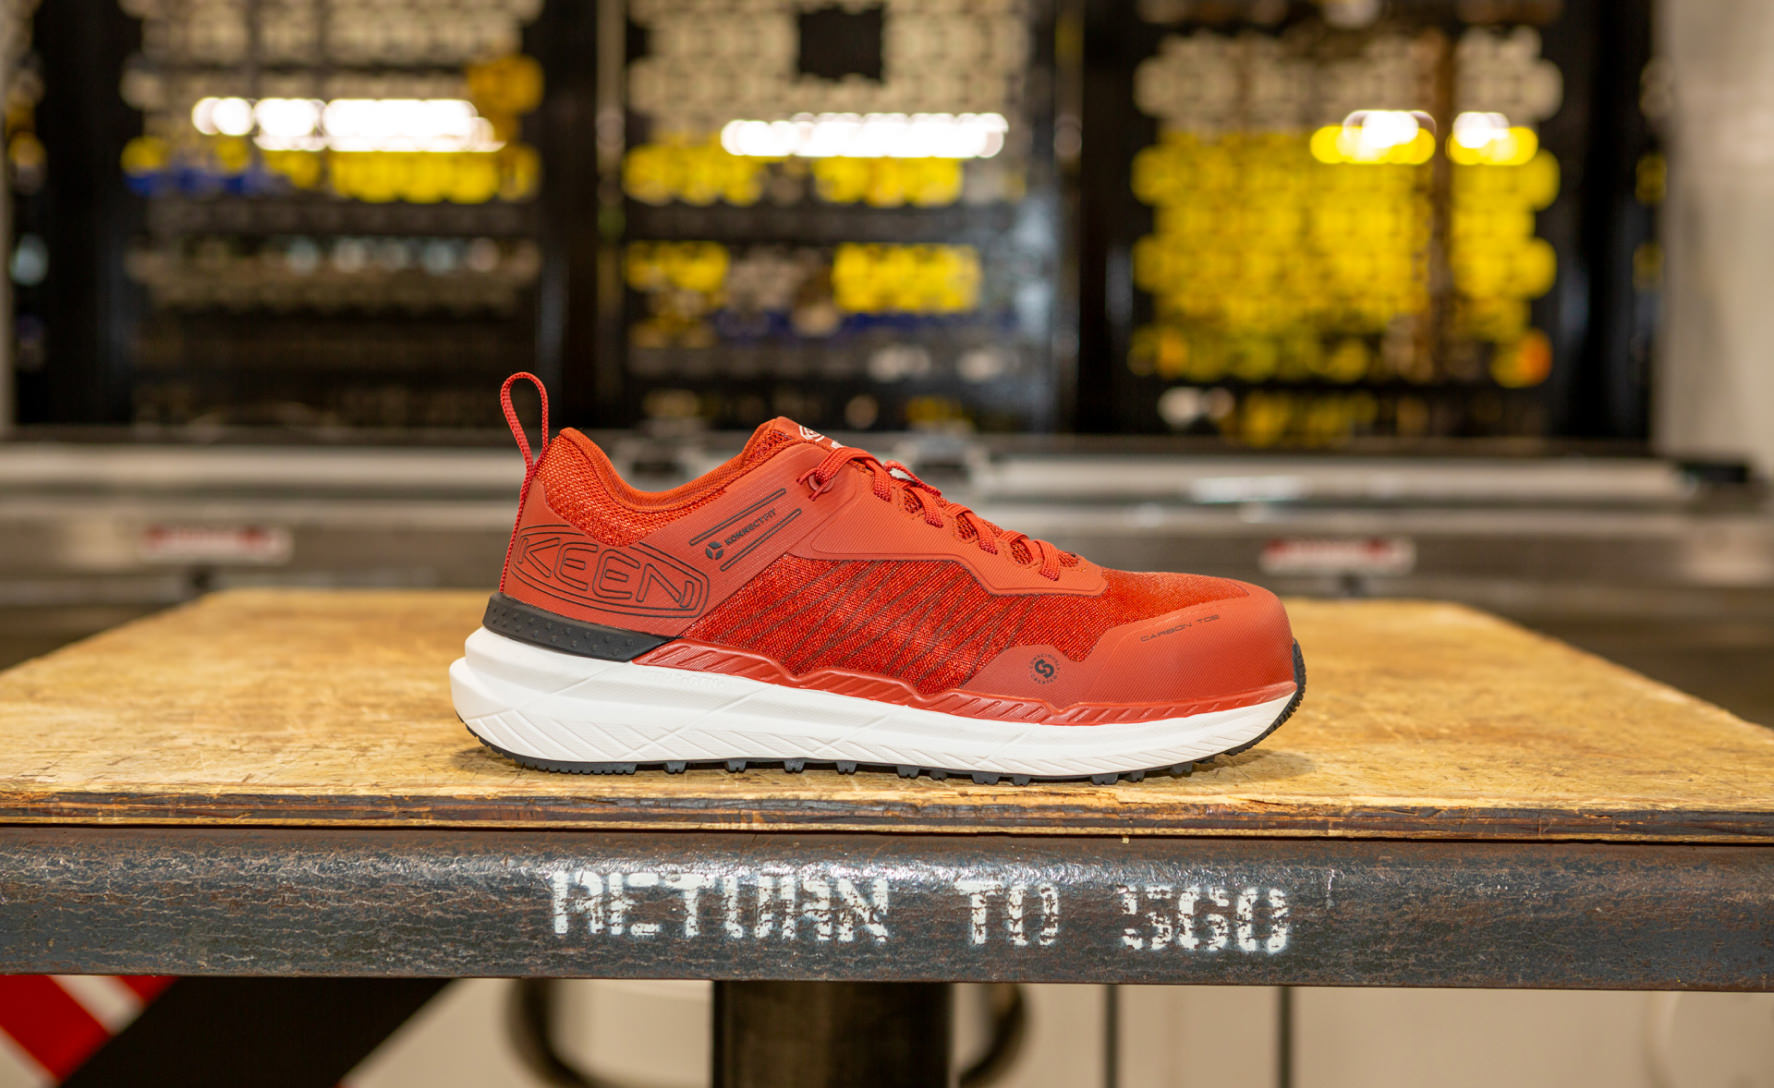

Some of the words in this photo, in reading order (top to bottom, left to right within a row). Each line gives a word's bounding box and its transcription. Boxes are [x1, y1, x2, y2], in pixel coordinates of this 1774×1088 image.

[517, 537, 694, 608] KEEN
[1139, 622, 1193, 642] CARBON
[553, 871, 889, 942] RETURN
[955, 879, 1059, 947] TO
